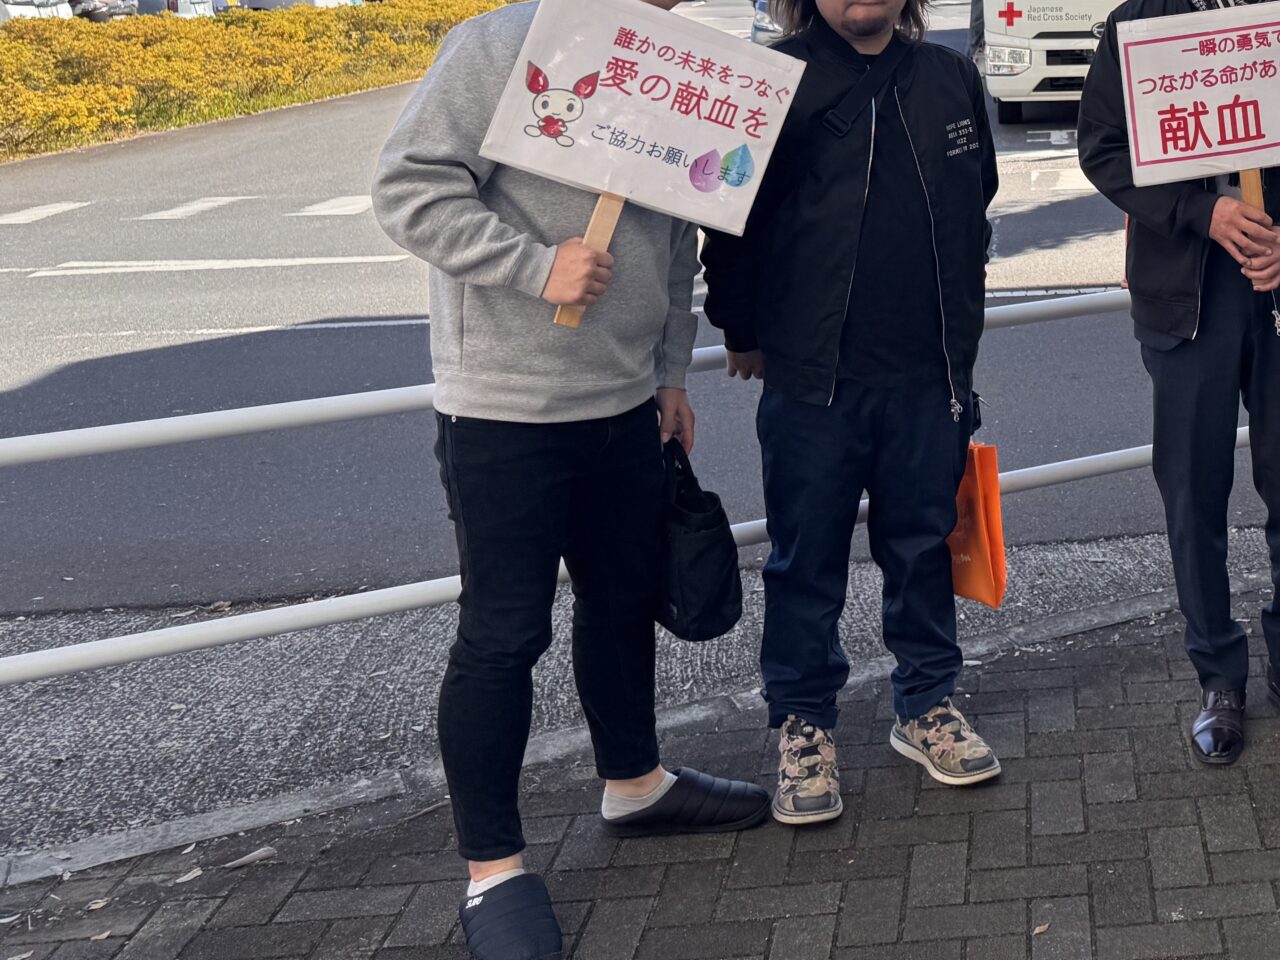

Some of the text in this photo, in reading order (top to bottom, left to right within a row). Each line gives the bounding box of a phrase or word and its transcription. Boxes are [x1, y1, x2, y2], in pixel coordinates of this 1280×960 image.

[1028, 4, 1064, 13] Japanese
[1043, 13, 1064, 21] Cross
[1065, 13, 1092, 22] Society
[613, 27, 790, 104] 誰かの未来をつなぐ
[599, 56, 769, 139] 愛の献血を
[1157, 94, 1266, 155] 献血
[590, 123, 751, 187] ご協力お願いします
